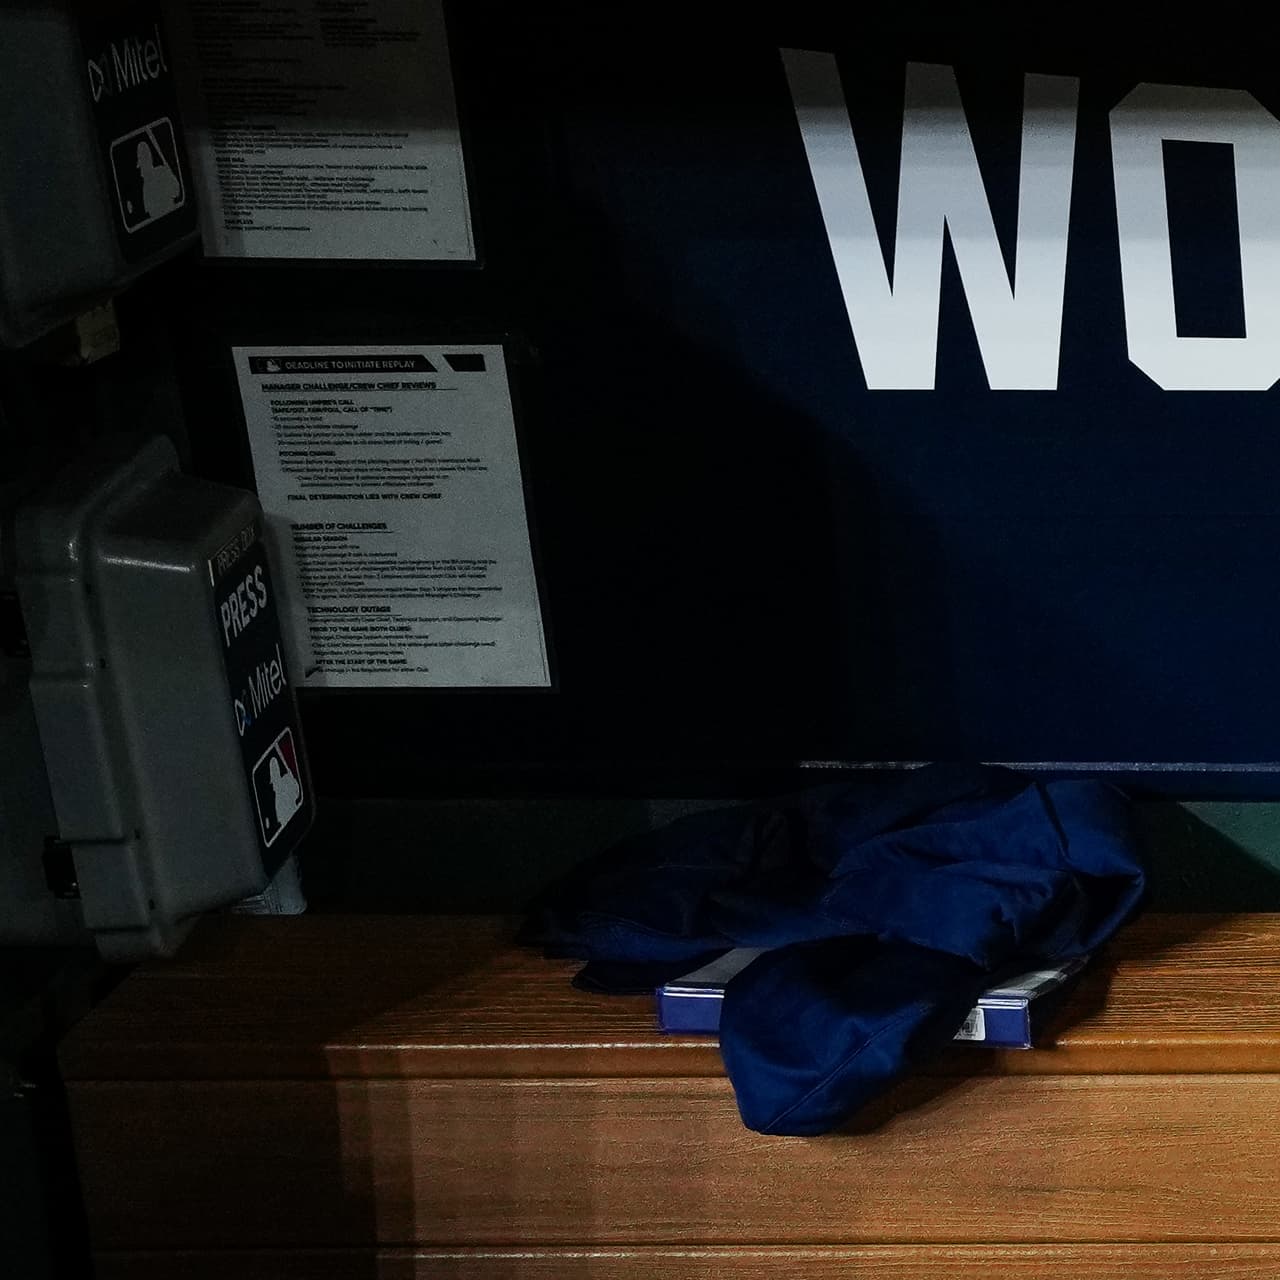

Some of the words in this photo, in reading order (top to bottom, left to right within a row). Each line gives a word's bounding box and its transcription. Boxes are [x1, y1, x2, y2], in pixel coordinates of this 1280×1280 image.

[110, 23, 169, 93] Mitel
[285, 361, 329, 370] DEADLINE
[331, 361, 344, 369] TO
[345, 360, 381, 369] INITIATE
[382, 360, 415, 369] REPLAY
[261, 383, 301, 391] MANAGER
[220, 564, 268, 649] PRESS
[306, 606, 358, 614] TECHNOLOGY
[247, 644, 289, 720] Mitel
